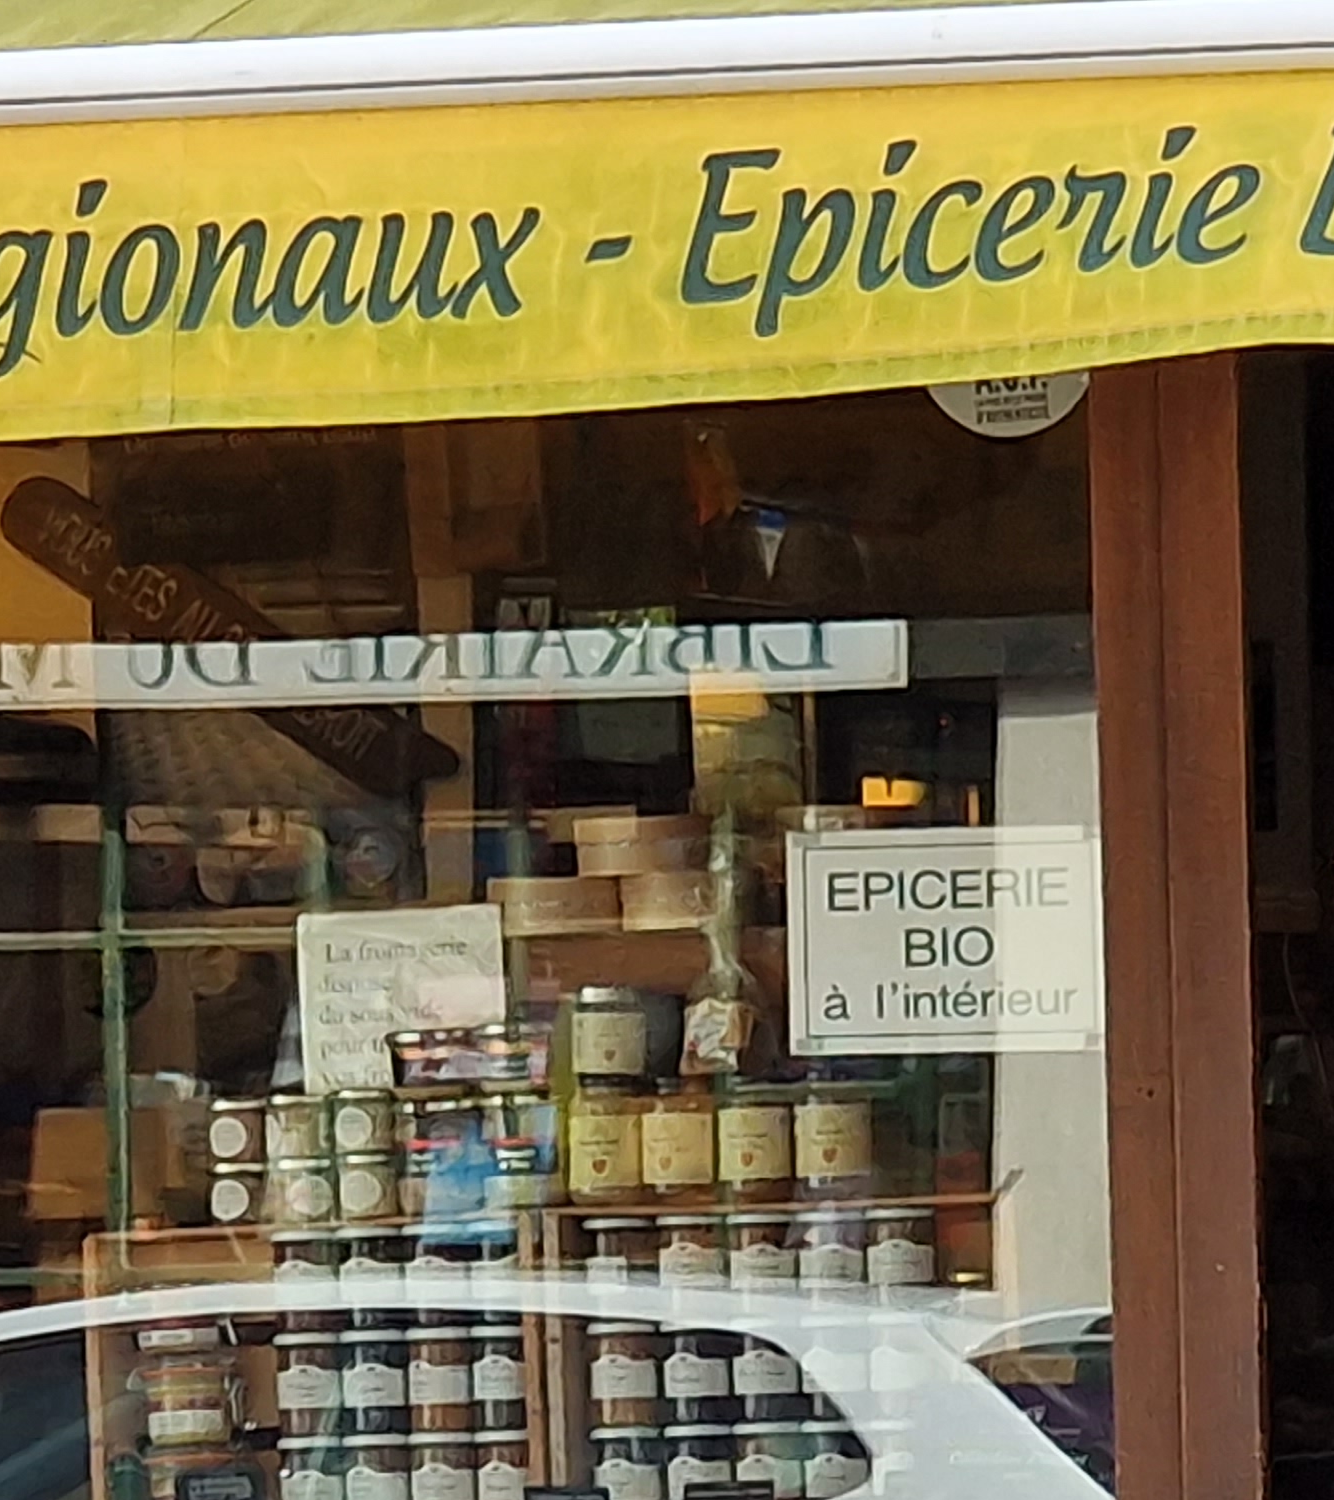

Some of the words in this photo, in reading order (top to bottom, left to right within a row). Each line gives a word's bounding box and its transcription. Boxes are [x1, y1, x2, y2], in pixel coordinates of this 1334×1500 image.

[678, 125, 1261, 338] Epicerie
[825, 866, 1070, 912] EPICERIE
[324, 943, 352, 964] La
[903, 925, 995, 969] BIO
[823, 984, 850, 1021] à
[876, 979, 1079, 1020] l'intérieur
